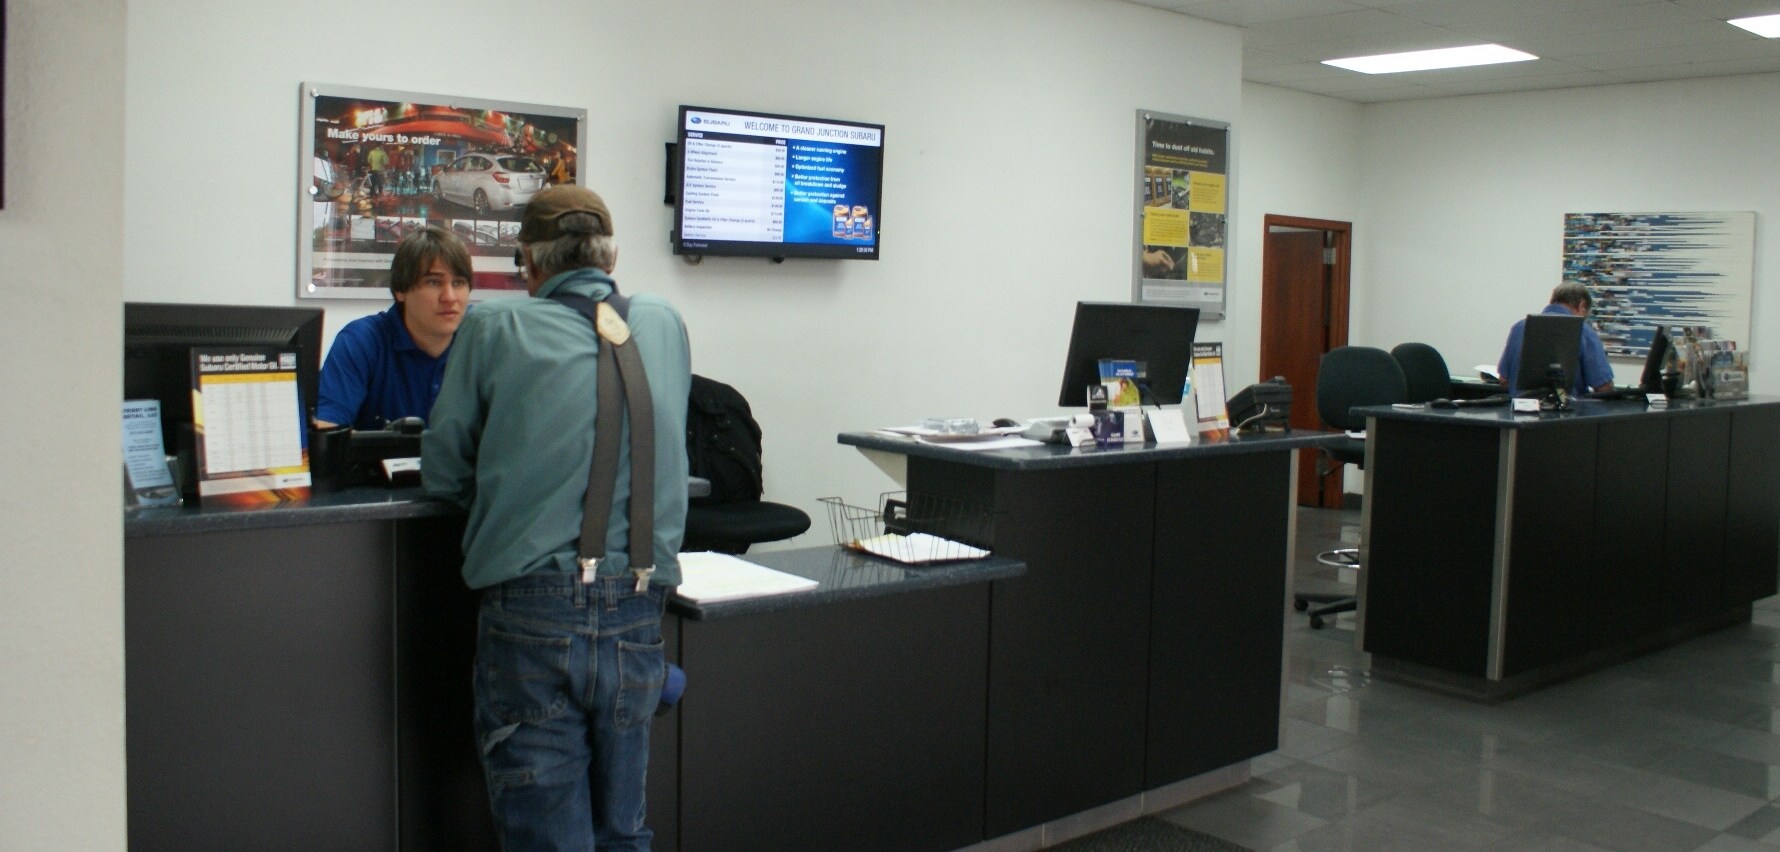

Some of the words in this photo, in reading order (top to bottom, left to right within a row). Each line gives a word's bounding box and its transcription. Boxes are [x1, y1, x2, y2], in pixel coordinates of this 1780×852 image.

[328, 128, 359, 140] Make
[362, 132, 394, 142] yours
[397, 134, 409, 143] to
[411, 136, 441, 145] order
[744, 121, 778, 132] WELCOME
[782, 124, 790, 133] TO
[792, 125, 814, 135] GRAND
[816, 128, 848, 139] JUNCTION
[850, 132, 876, 141] SUBARU
[200, 363, 224, 372] Subaru
